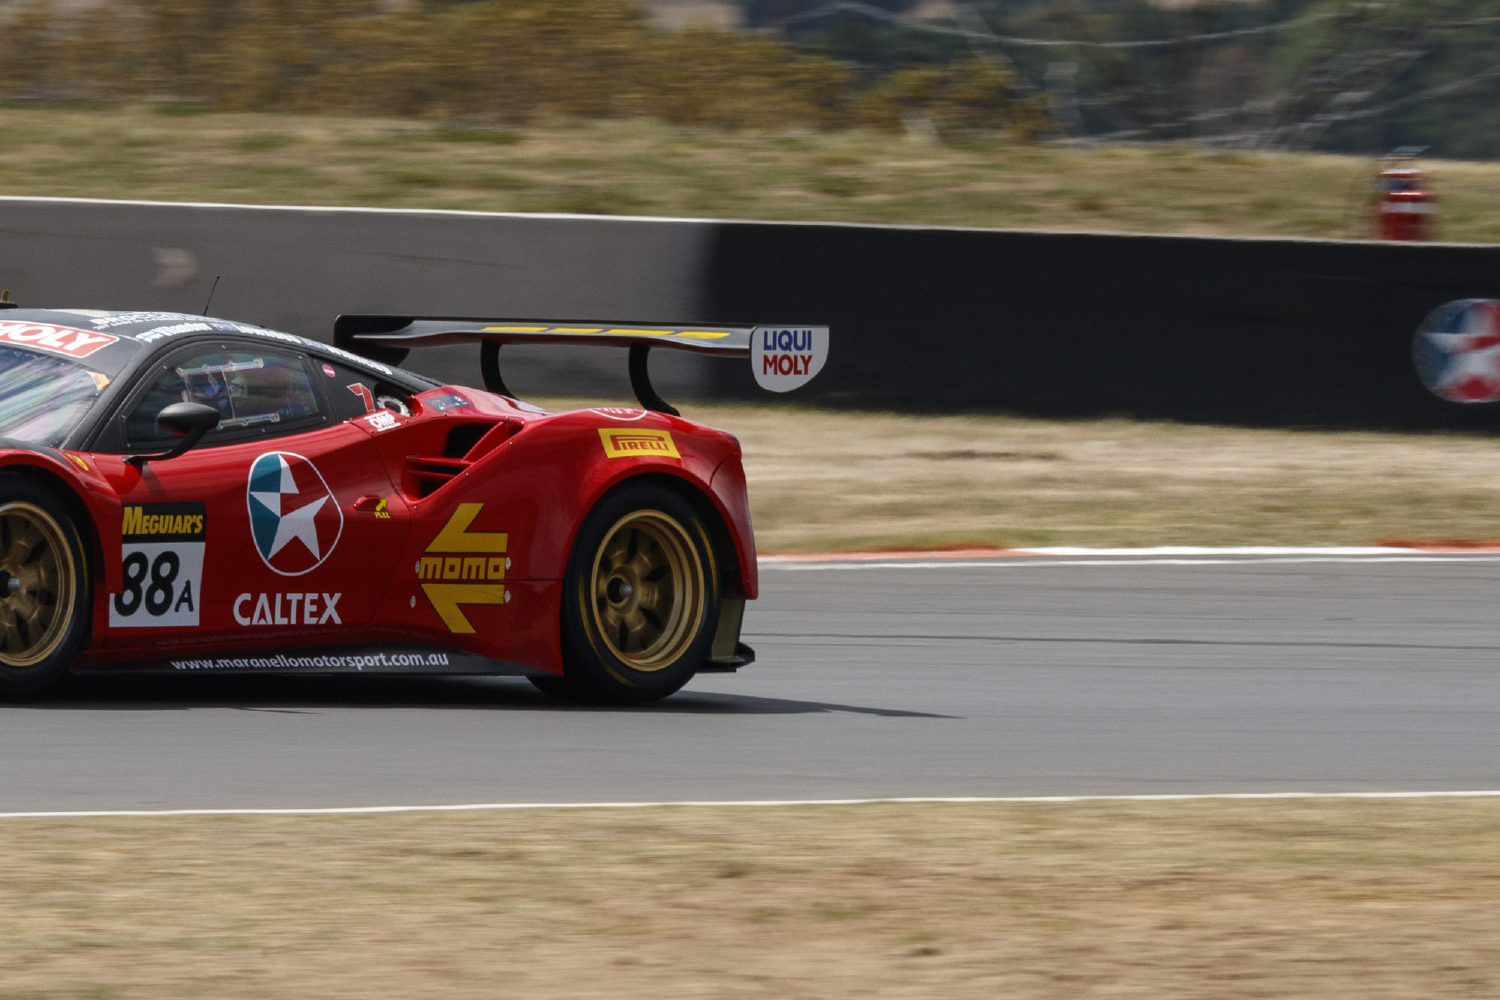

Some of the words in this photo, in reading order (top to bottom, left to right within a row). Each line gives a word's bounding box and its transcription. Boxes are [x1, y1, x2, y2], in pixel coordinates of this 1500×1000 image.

[763, 330, 812, 351] LIQUI
[763, 354, 812, 376] MOLY
[610, 434, 670, 451] PIRELLI
[122, 506, 204, 535] MEGUIAR'S
[418, 556, 506, 580] momo
[233, 592, 343, 626] CALTEX
[171, 652, 449, 671] www.maranellomotorsport.com.au
